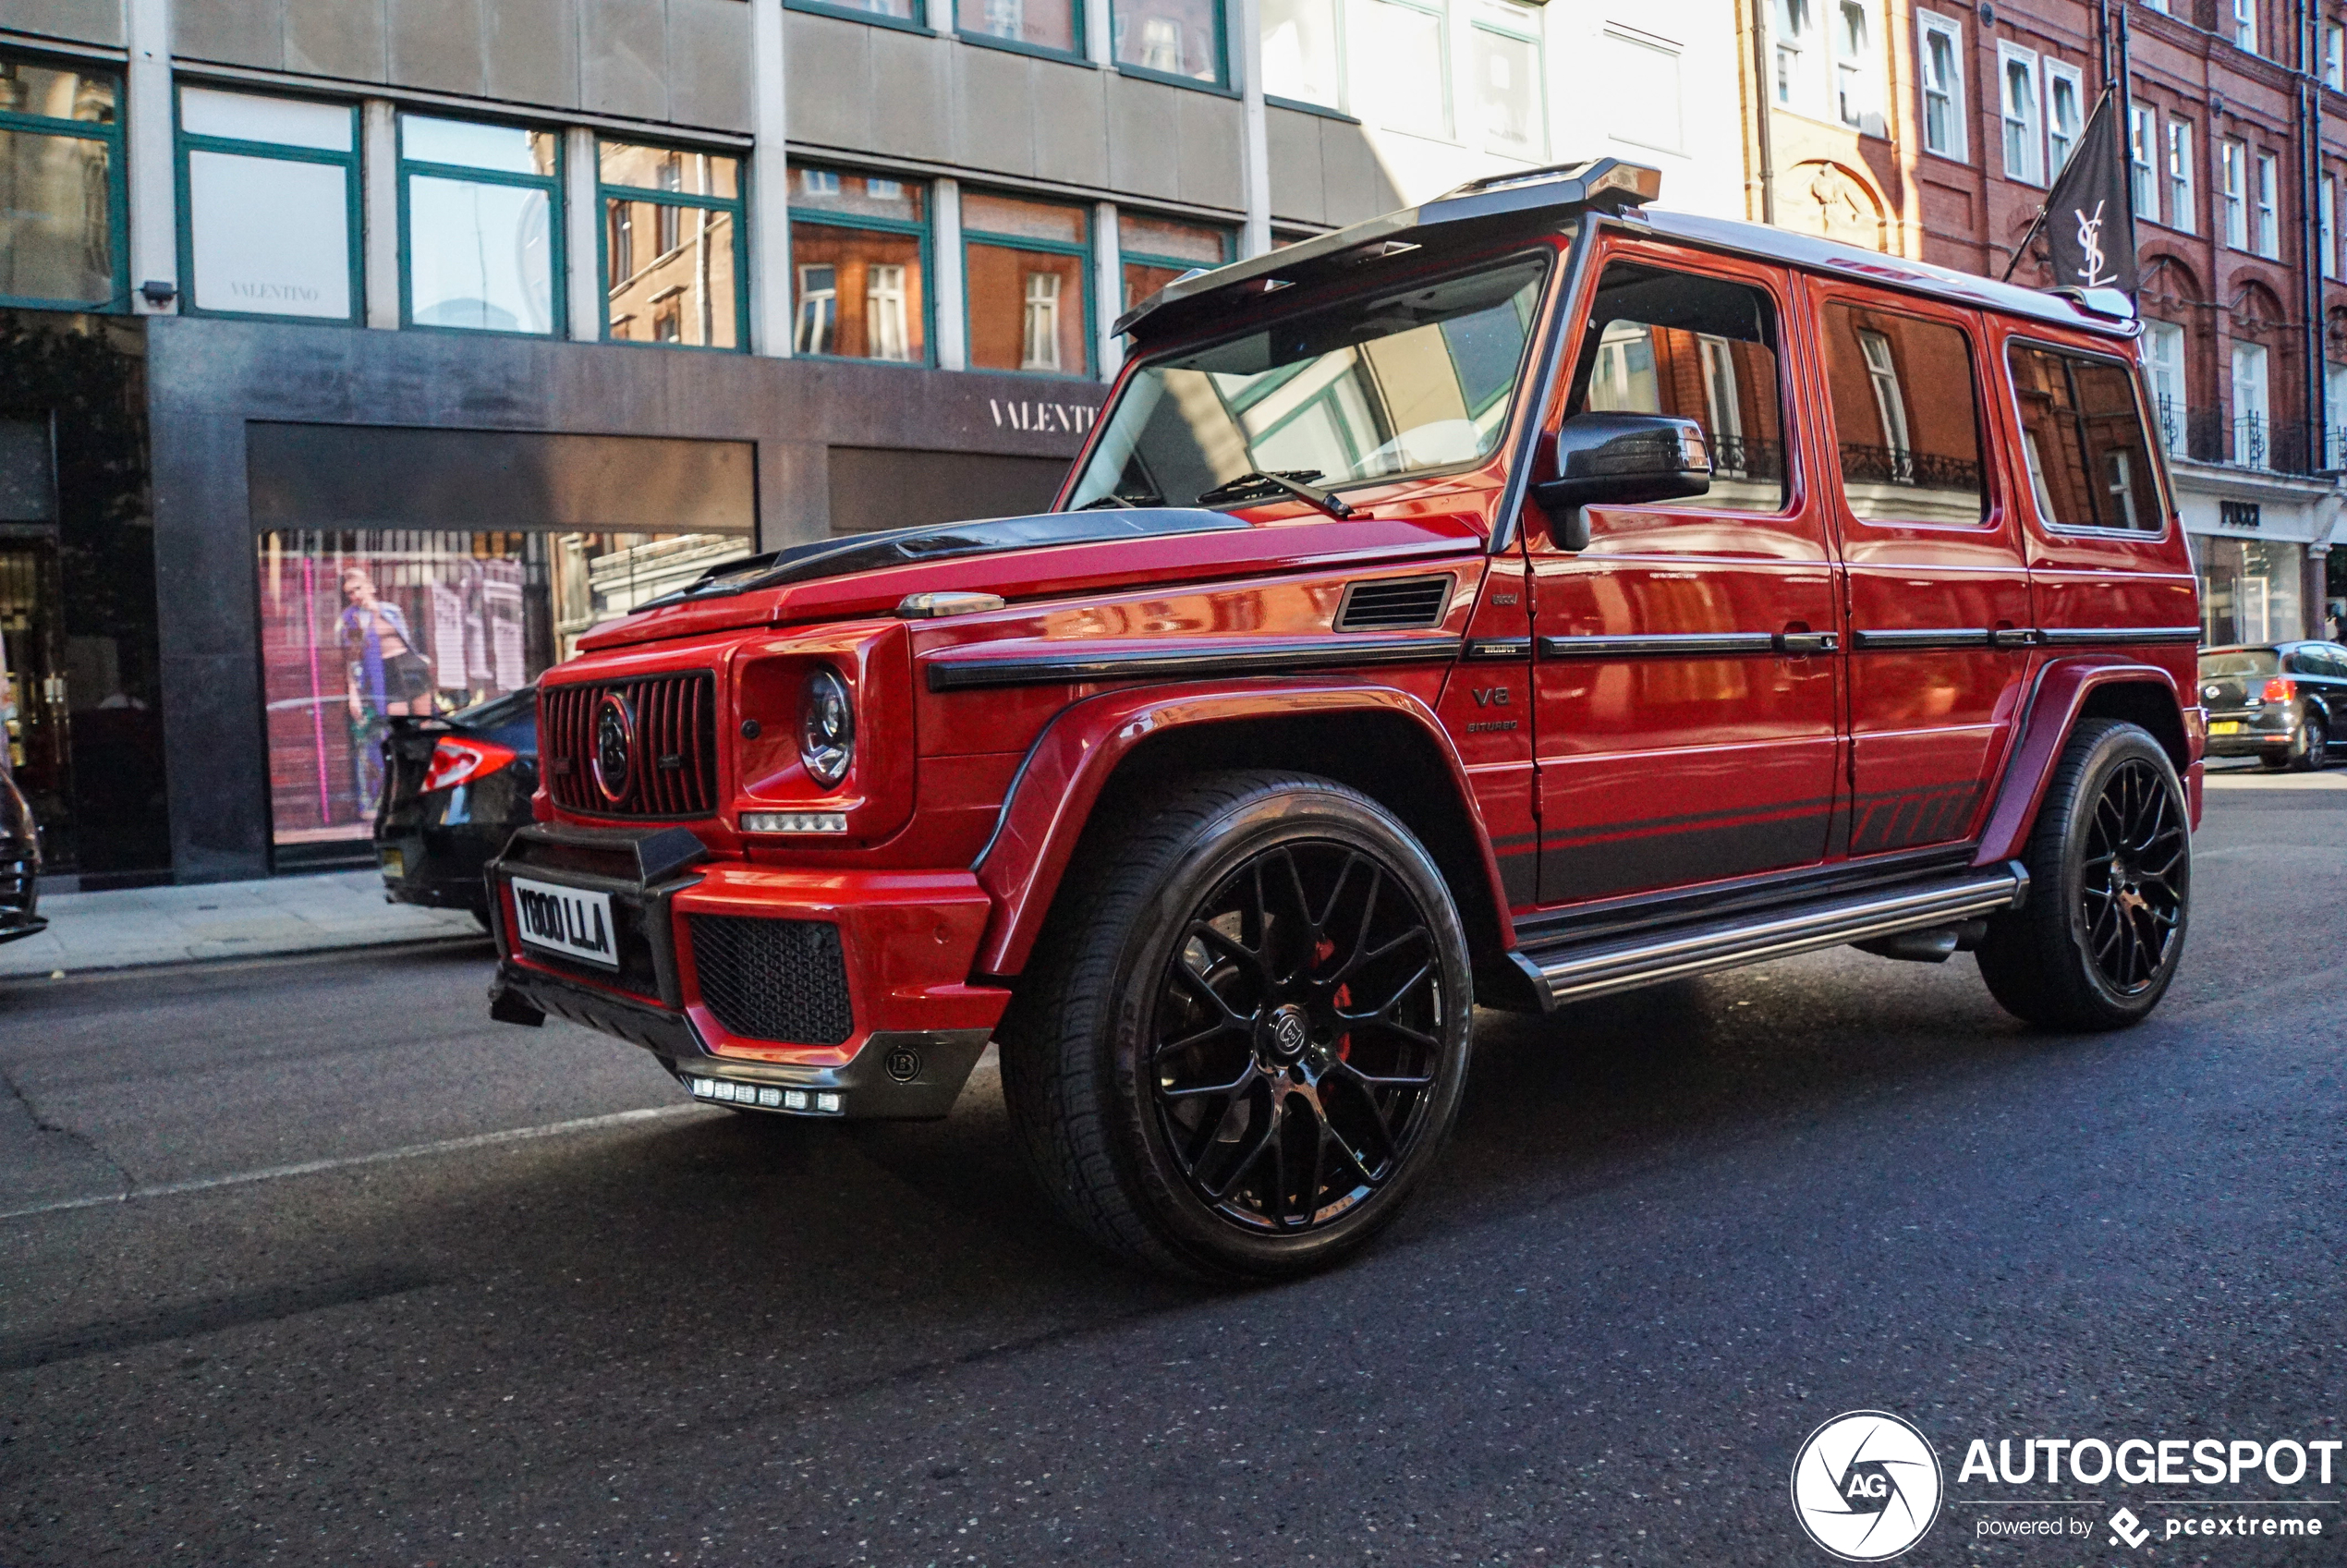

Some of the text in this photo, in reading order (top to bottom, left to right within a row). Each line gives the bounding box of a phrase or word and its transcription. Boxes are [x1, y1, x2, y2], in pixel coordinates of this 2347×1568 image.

[990, 398, 1101, 434] VALENTI
[2219, 500, 2260, 527] PUCCI
[1472, 687, 1510, 707] V8
[1467, 720, 1518, 734] BITURBO
[564, 896, 610, 954] LLA
